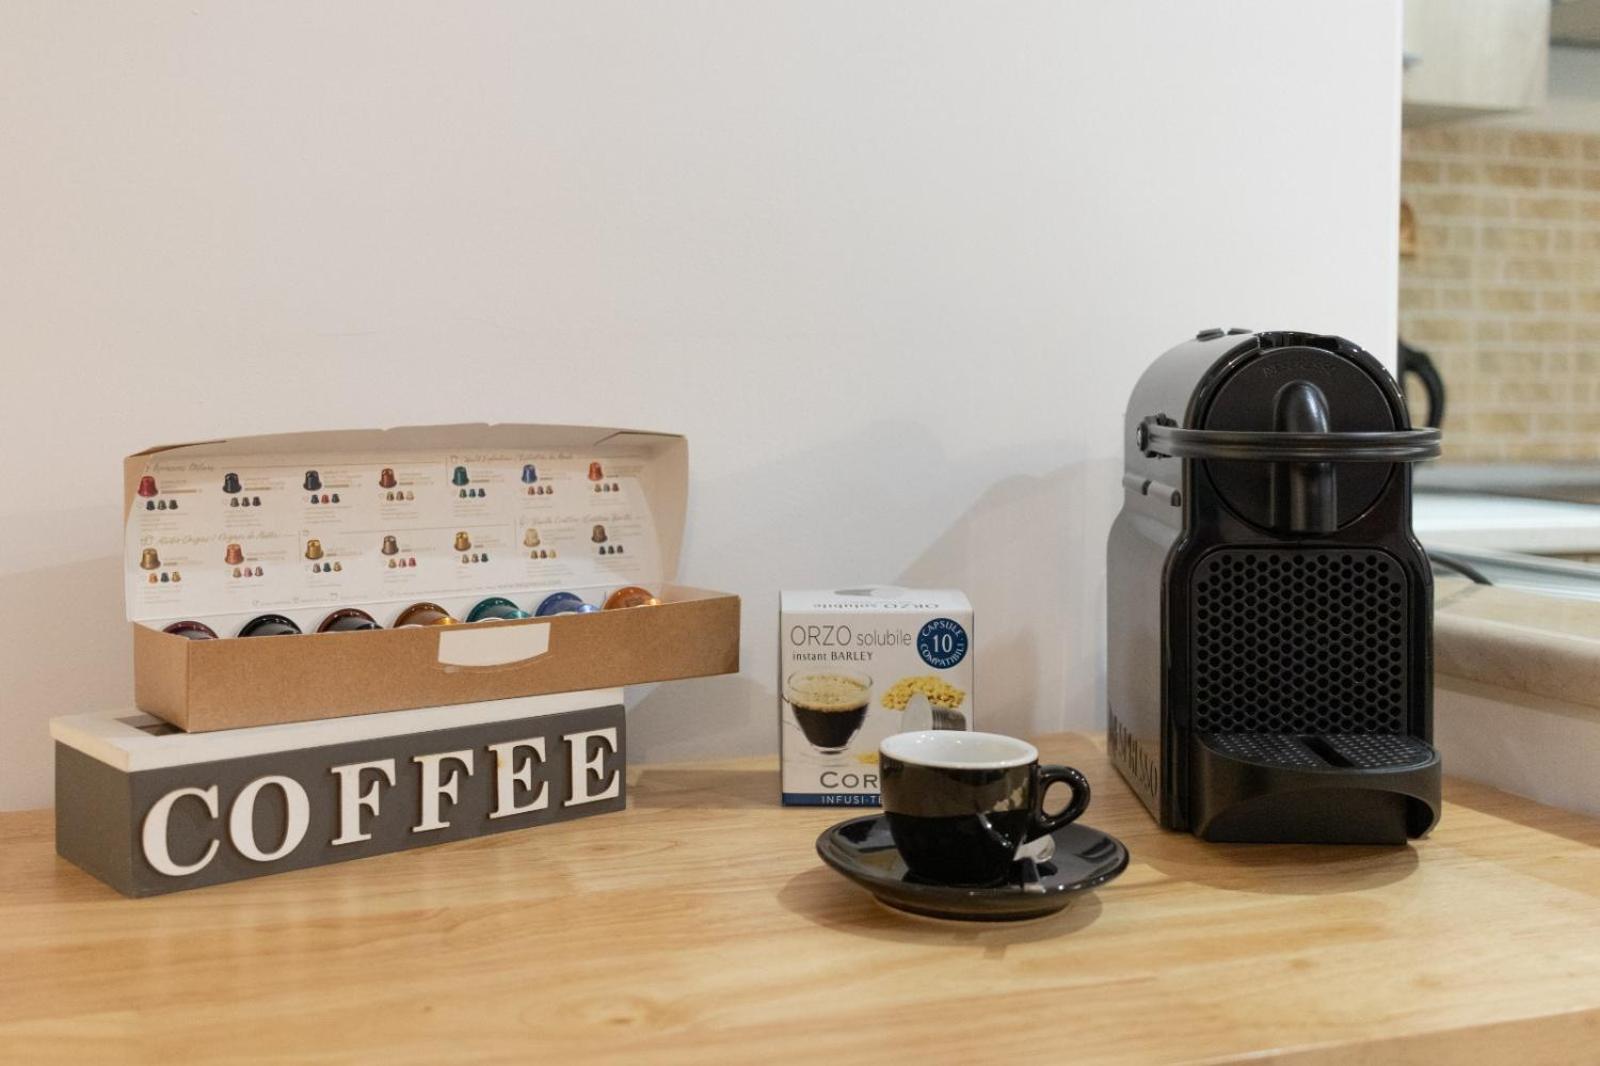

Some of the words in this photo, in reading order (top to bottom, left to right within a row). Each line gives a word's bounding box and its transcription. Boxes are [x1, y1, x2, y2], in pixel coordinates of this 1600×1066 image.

[790, 624, 852, 646] ORZO
[856, 629, 912, 647] solubile
[922, 620, 962, 638] CAPSULE
[932, 633, 953, 653] 10
[792, 650, 827, 661] instant
[831, 651, 874, 661] BARLEY
[820, 771, 878, 789] COR
[142, 726, 621, 877] COFFEE
[821, 795, 864, 805] INFUSI
